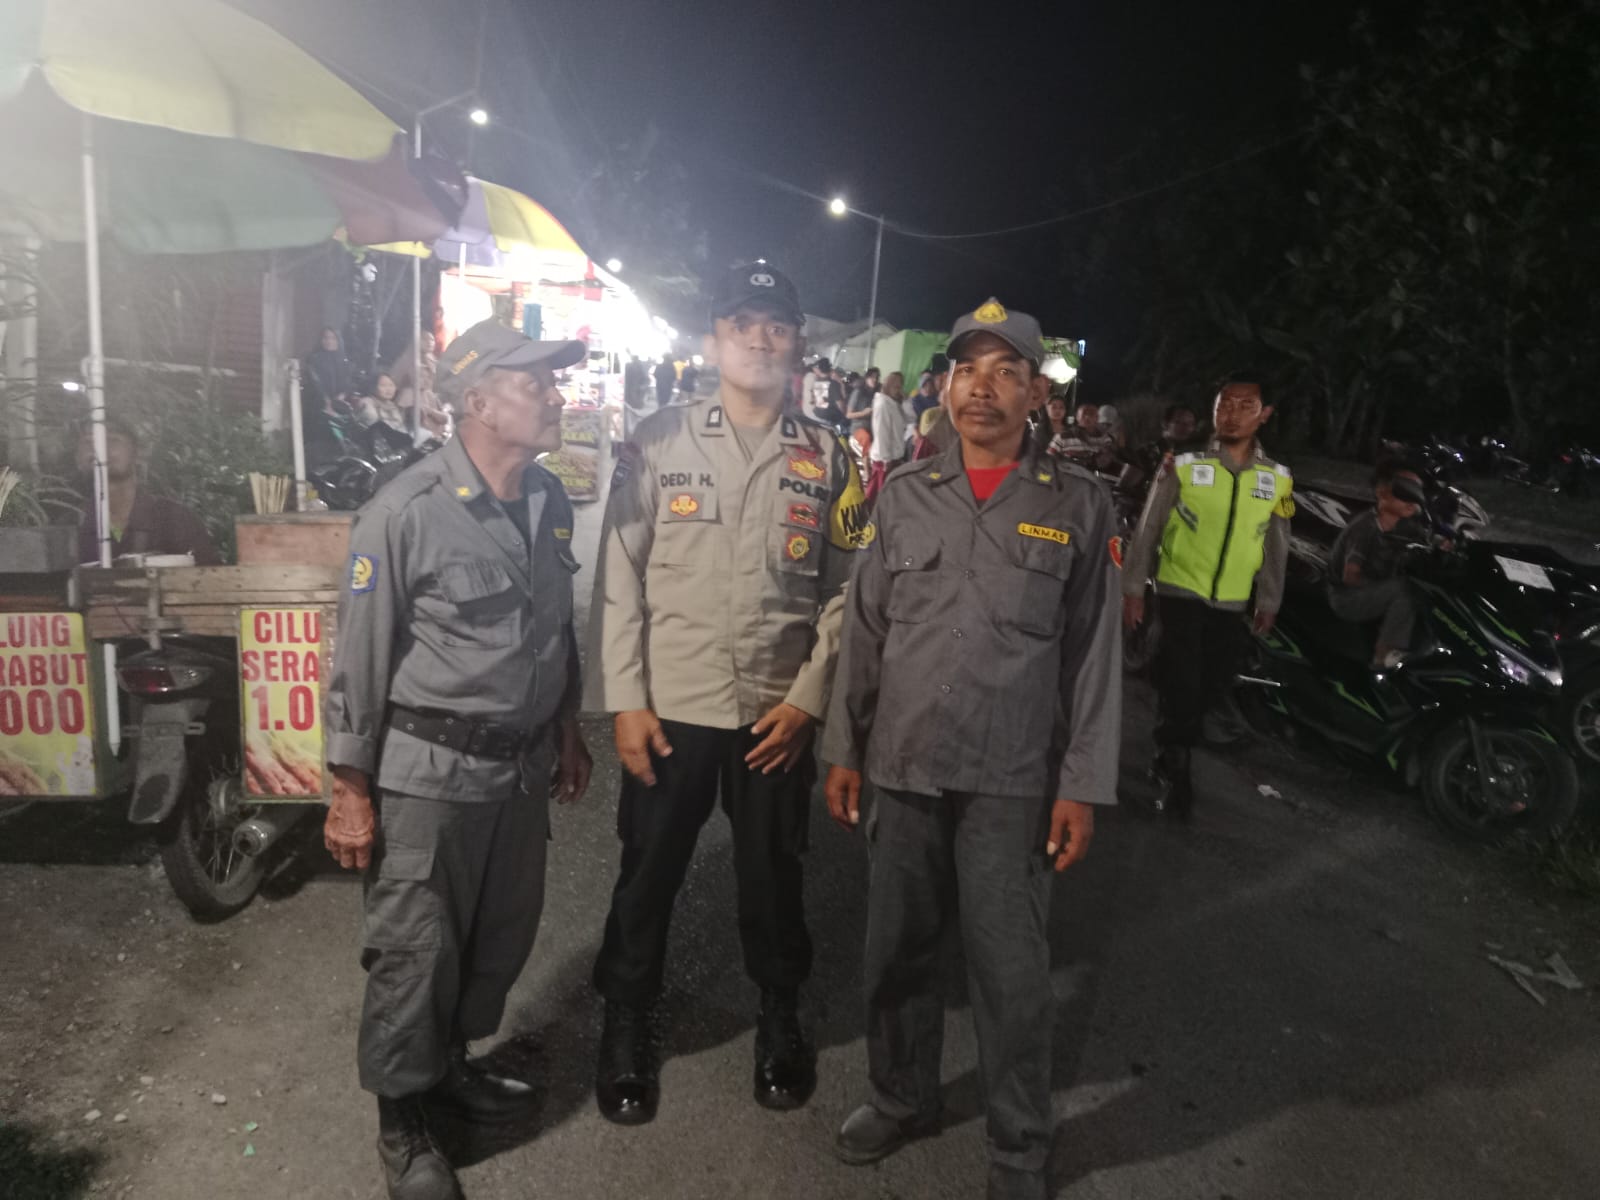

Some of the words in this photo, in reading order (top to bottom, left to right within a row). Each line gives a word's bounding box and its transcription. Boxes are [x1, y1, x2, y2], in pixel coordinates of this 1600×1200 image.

[660, 472, 692, 488] DEDI
[699, 473, 715, 488] H.
[1020, 524, 1066, 543] LINMAS
[254, 611, 321, 643] CILU
[242, 650, 320, 683] SERA
[0, 688, 85, 736] 000
[251, 685, 315, 732] 1.0
